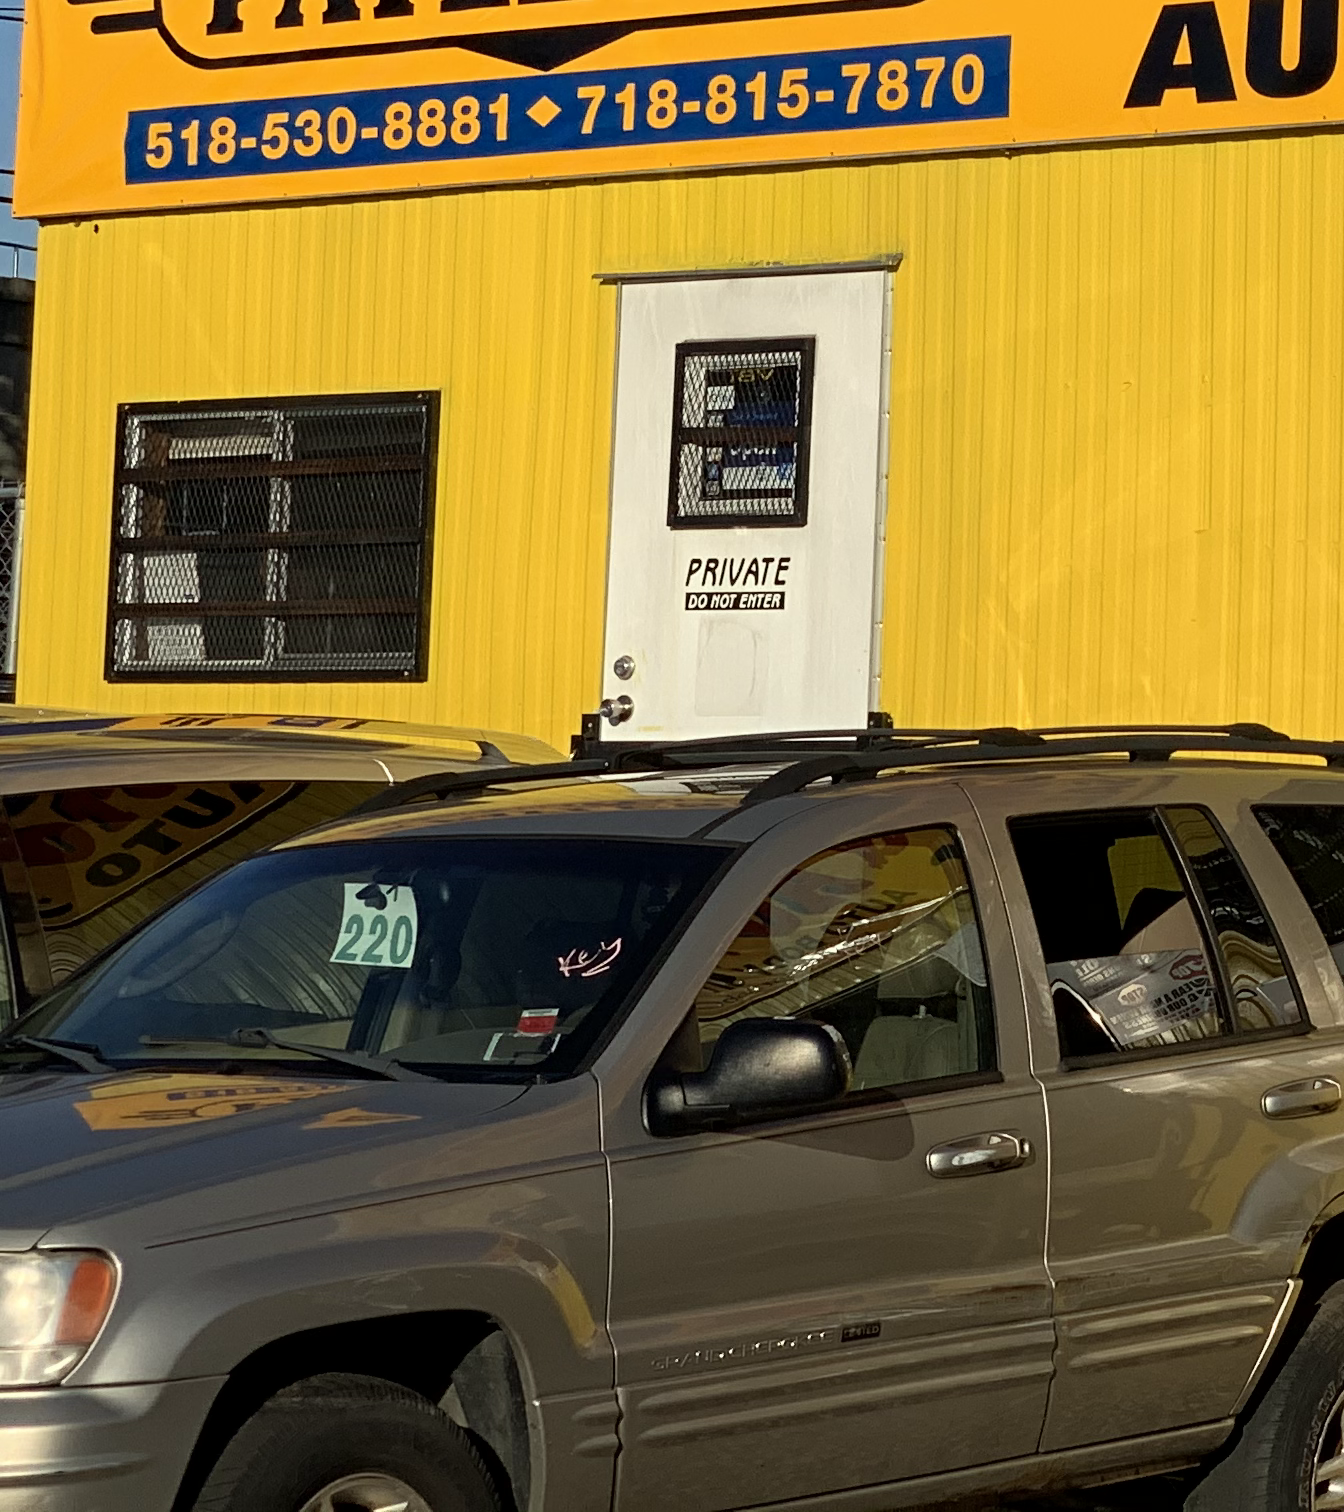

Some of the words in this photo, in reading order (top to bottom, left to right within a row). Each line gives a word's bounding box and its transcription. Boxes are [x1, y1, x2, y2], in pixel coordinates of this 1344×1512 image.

[145, 93, 510, 169] 518-530-8881
[577, 52, 985, 136] 718-815-7870
[686, 557, 791, 587] PRIVATE
[688, 594, 707, 609] DO
[711, 594, 737, 609] NOT
[739, 593, 782, 609] ENTER
[335, 914, 413, 965] 220
